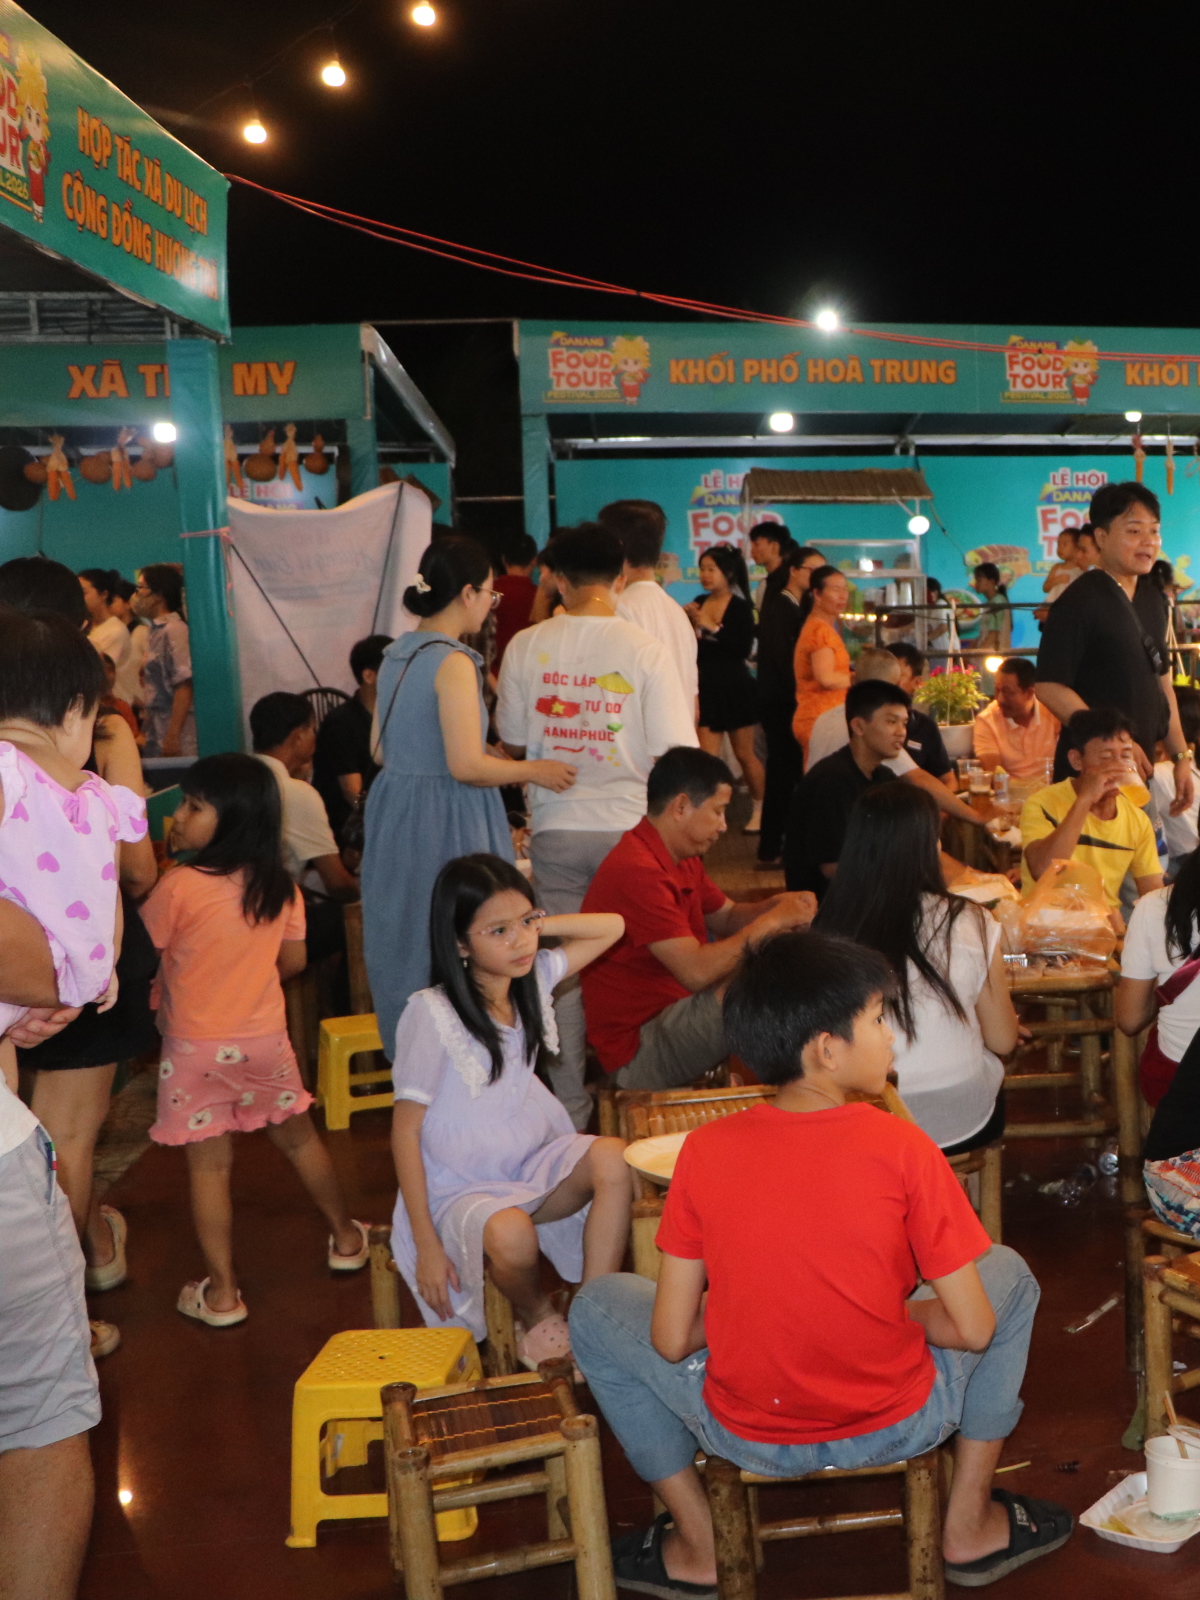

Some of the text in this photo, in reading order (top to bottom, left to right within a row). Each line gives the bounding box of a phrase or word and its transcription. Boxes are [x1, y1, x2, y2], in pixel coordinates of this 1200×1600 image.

[77, 106, 112, 169] HỢP
[114, 134, 142, 192] TÁC
[144, 156, 164, 207] XÃ
[165, 172, 182, 219] DU
[184, 186, 208, 236] LỊCH
[62, 169, 108, 240] CỘNG
[111, 197, 152, 265] ĐỒNG
[560, 337, 605, 347] DANANG
[550, 349, 613, 370] FOOD
[669, 351, 957, 385] KHỐI PHỐ HOÀ TRUNG
[1008, 353, 1065, 372] FOOD
[67, 360, 129, 399] XÃ
[232, 361, 296, 397] MY
[551, 371, 613, 388] TOUR
[1009, 372, 1065, 390] TOUR
[1124, 357, 1190, 387] KHỐI
[704, 493, 741, 506] DAN
[1053, 491, 1093, 502] DANA
[542, 671, 596, 688] ĐỘC LẬP
[585, 700, 622, 714] TỰ DO
